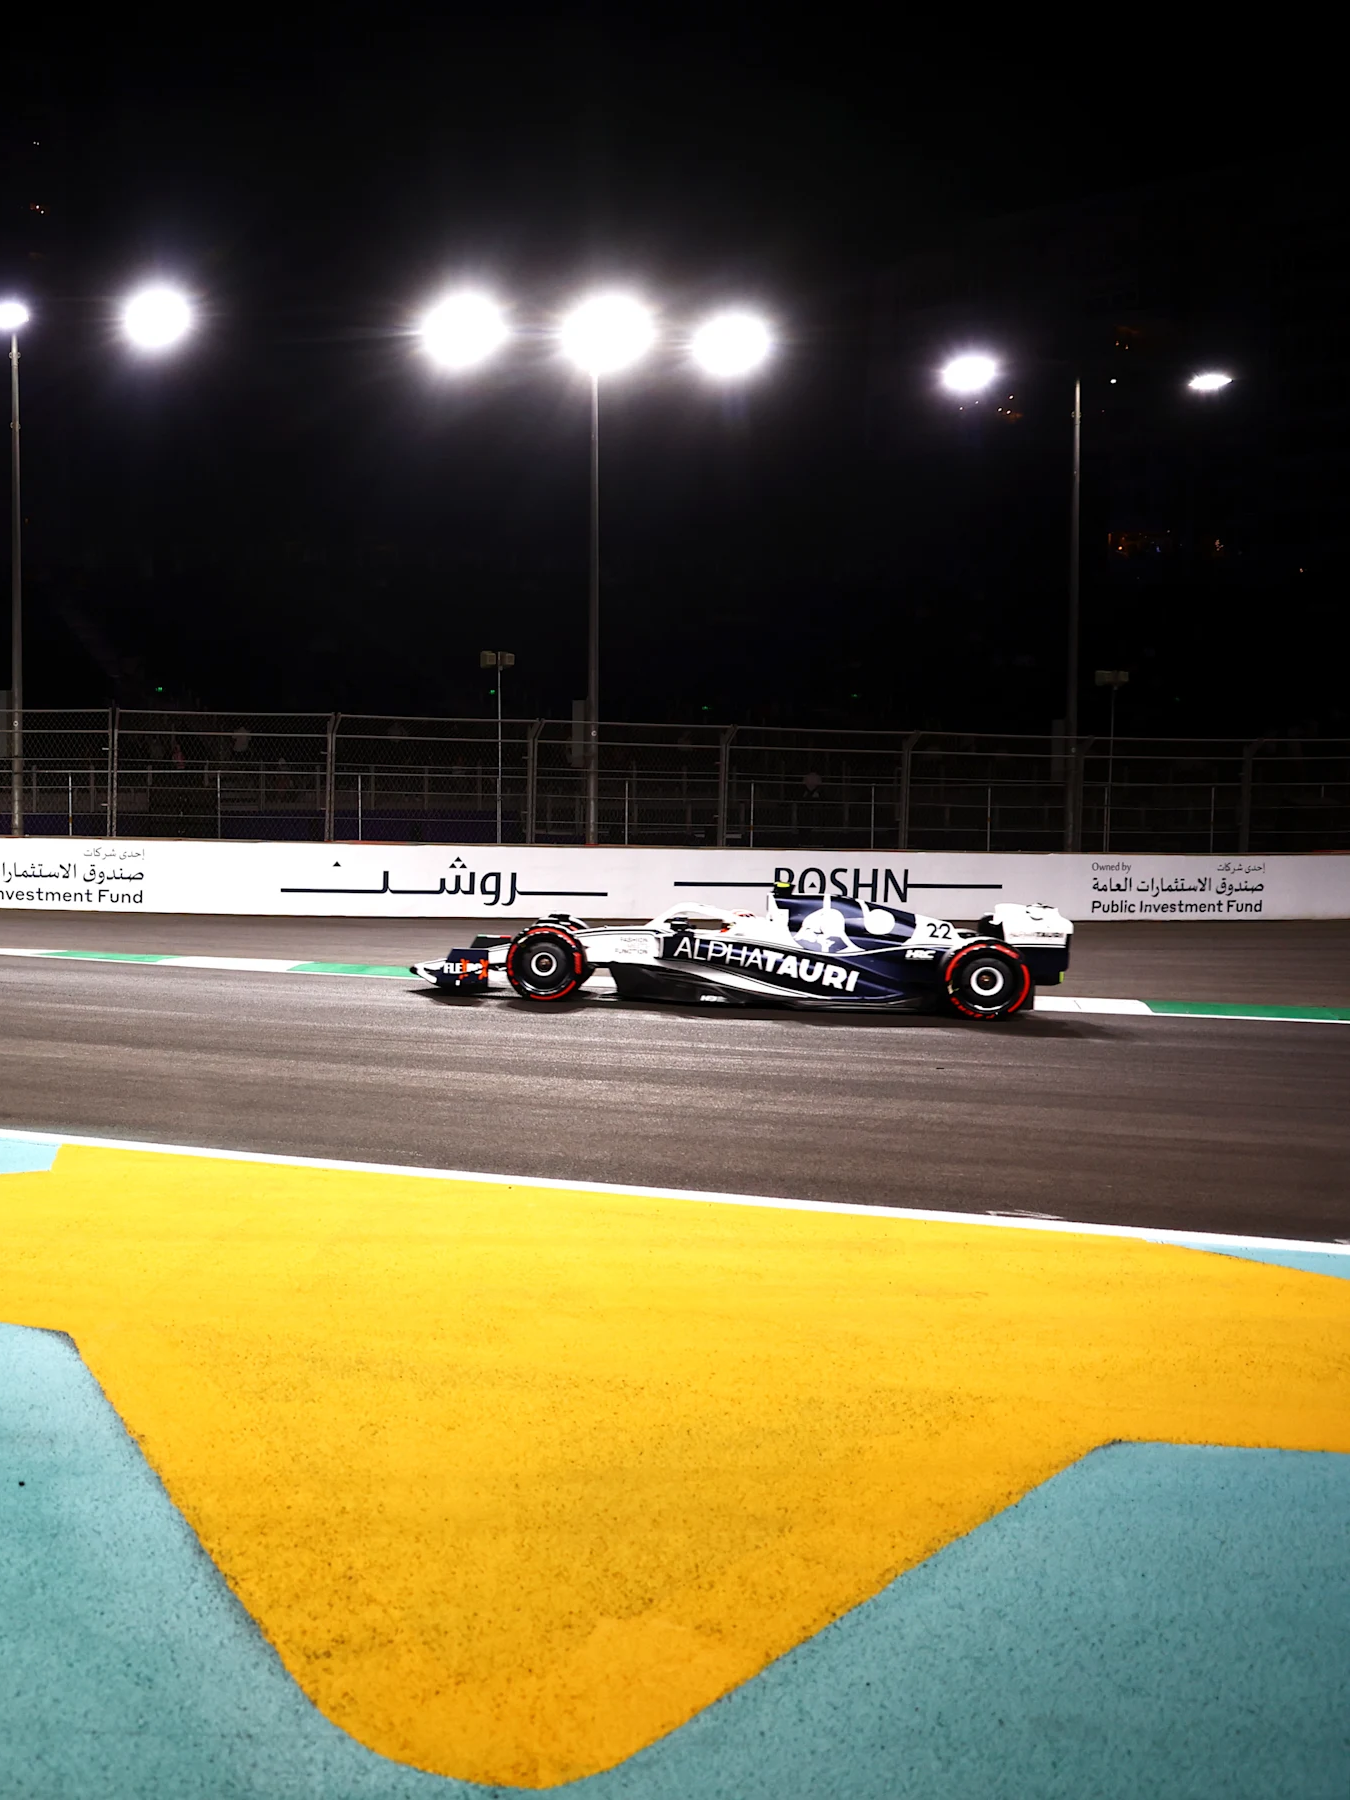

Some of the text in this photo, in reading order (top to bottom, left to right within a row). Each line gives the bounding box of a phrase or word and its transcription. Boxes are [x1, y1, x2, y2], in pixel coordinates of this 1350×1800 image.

[83, 846, 117, 861] شركات
[83, 865, 144, 884] صندوق
[1091, 862, 1132, 873] Owned by
[1216, 861, 1244, 875] شركات
[1093, 877, 1264, 897] صندوق الاستثمارات العامة
[99, 890, 142, 903] Fund
[1092, 900, 1262, 913] Public Investment Fund
[926, 922, 952, 940] 22
[673, 936, 860, 992] ALPHATAURI
